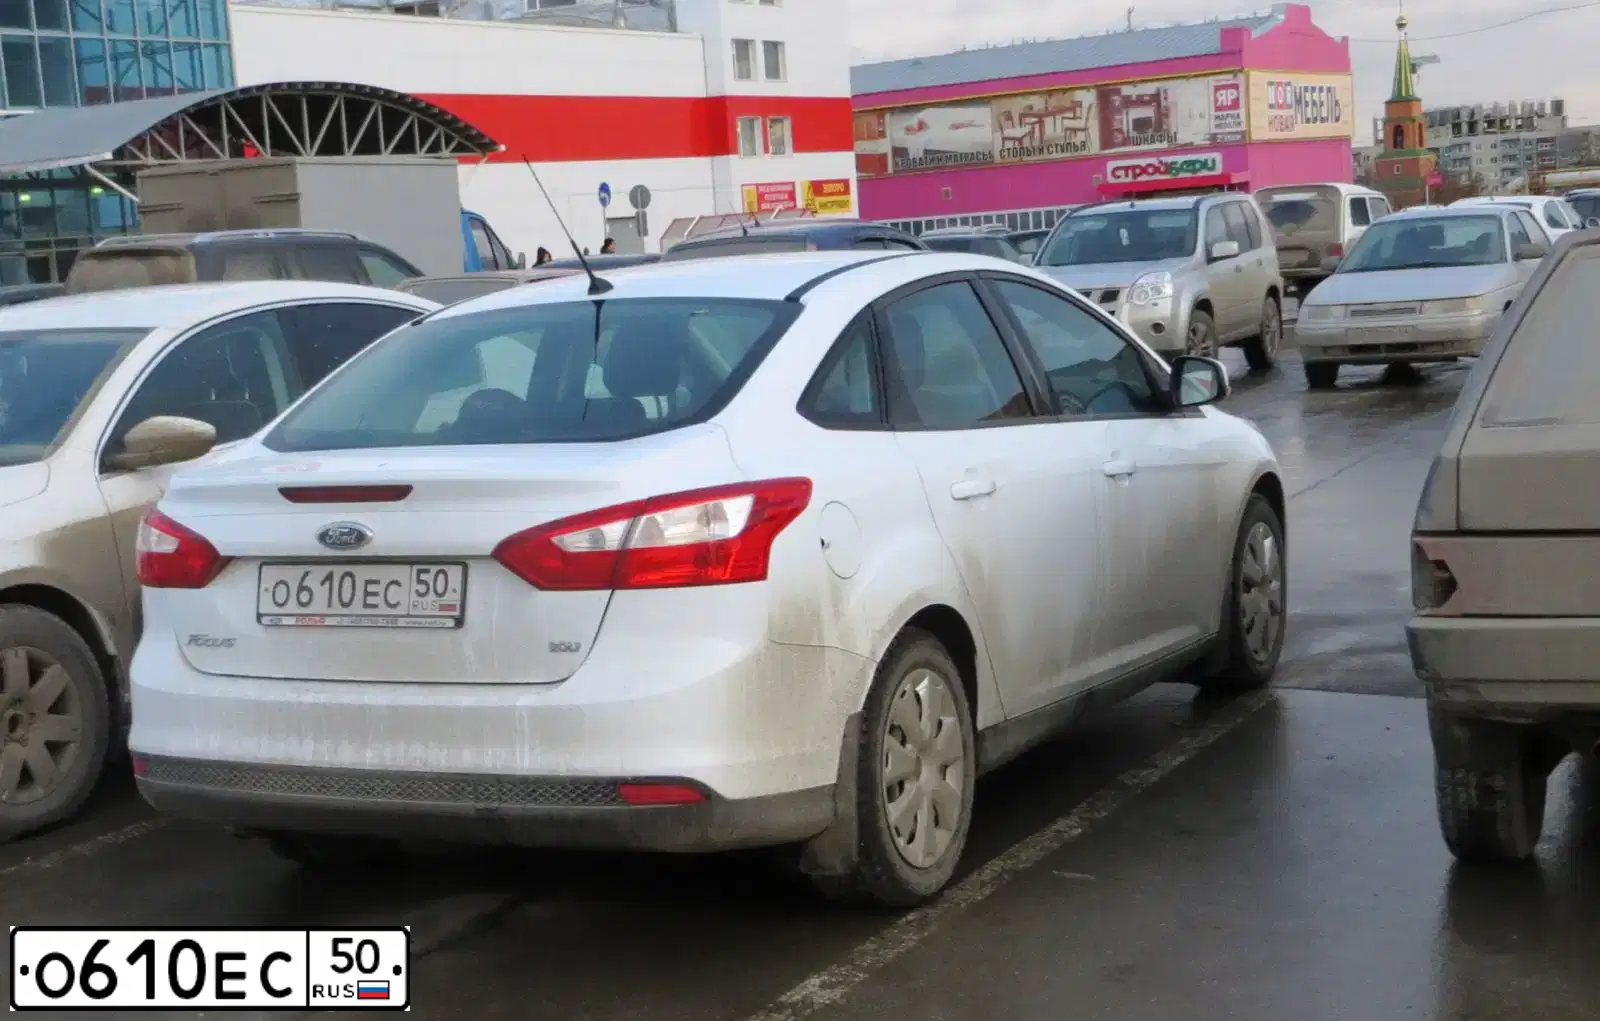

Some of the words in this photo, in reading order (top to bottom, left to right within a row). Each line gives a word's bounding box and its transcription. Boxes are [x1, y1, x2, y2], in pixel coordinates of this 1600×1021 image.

[1215, 88, 1239, 107] ЯР
[1294, 86, 1341, 124] МЕБЕЛЬ
[1268, 115, 1294, 132] НОВАЯ
[1132, 131, 1177, 146] ШКАФЫ
[894, 155, 934, 168] КРОВАТИ
[936, 156, 943, 166] И
[945, 149, 994, 165] МАТРАСЫ
[999, 145, 1035, 159] СТОЛЫ
[1037, 145, 1044, 156] И
[1047, 140, 1087, 155] СТУЛЬЯ
[325, 528, 358, 546] Ford
[415, 568, 448, 598] 50
[411, 600, 437, 610] RUS
